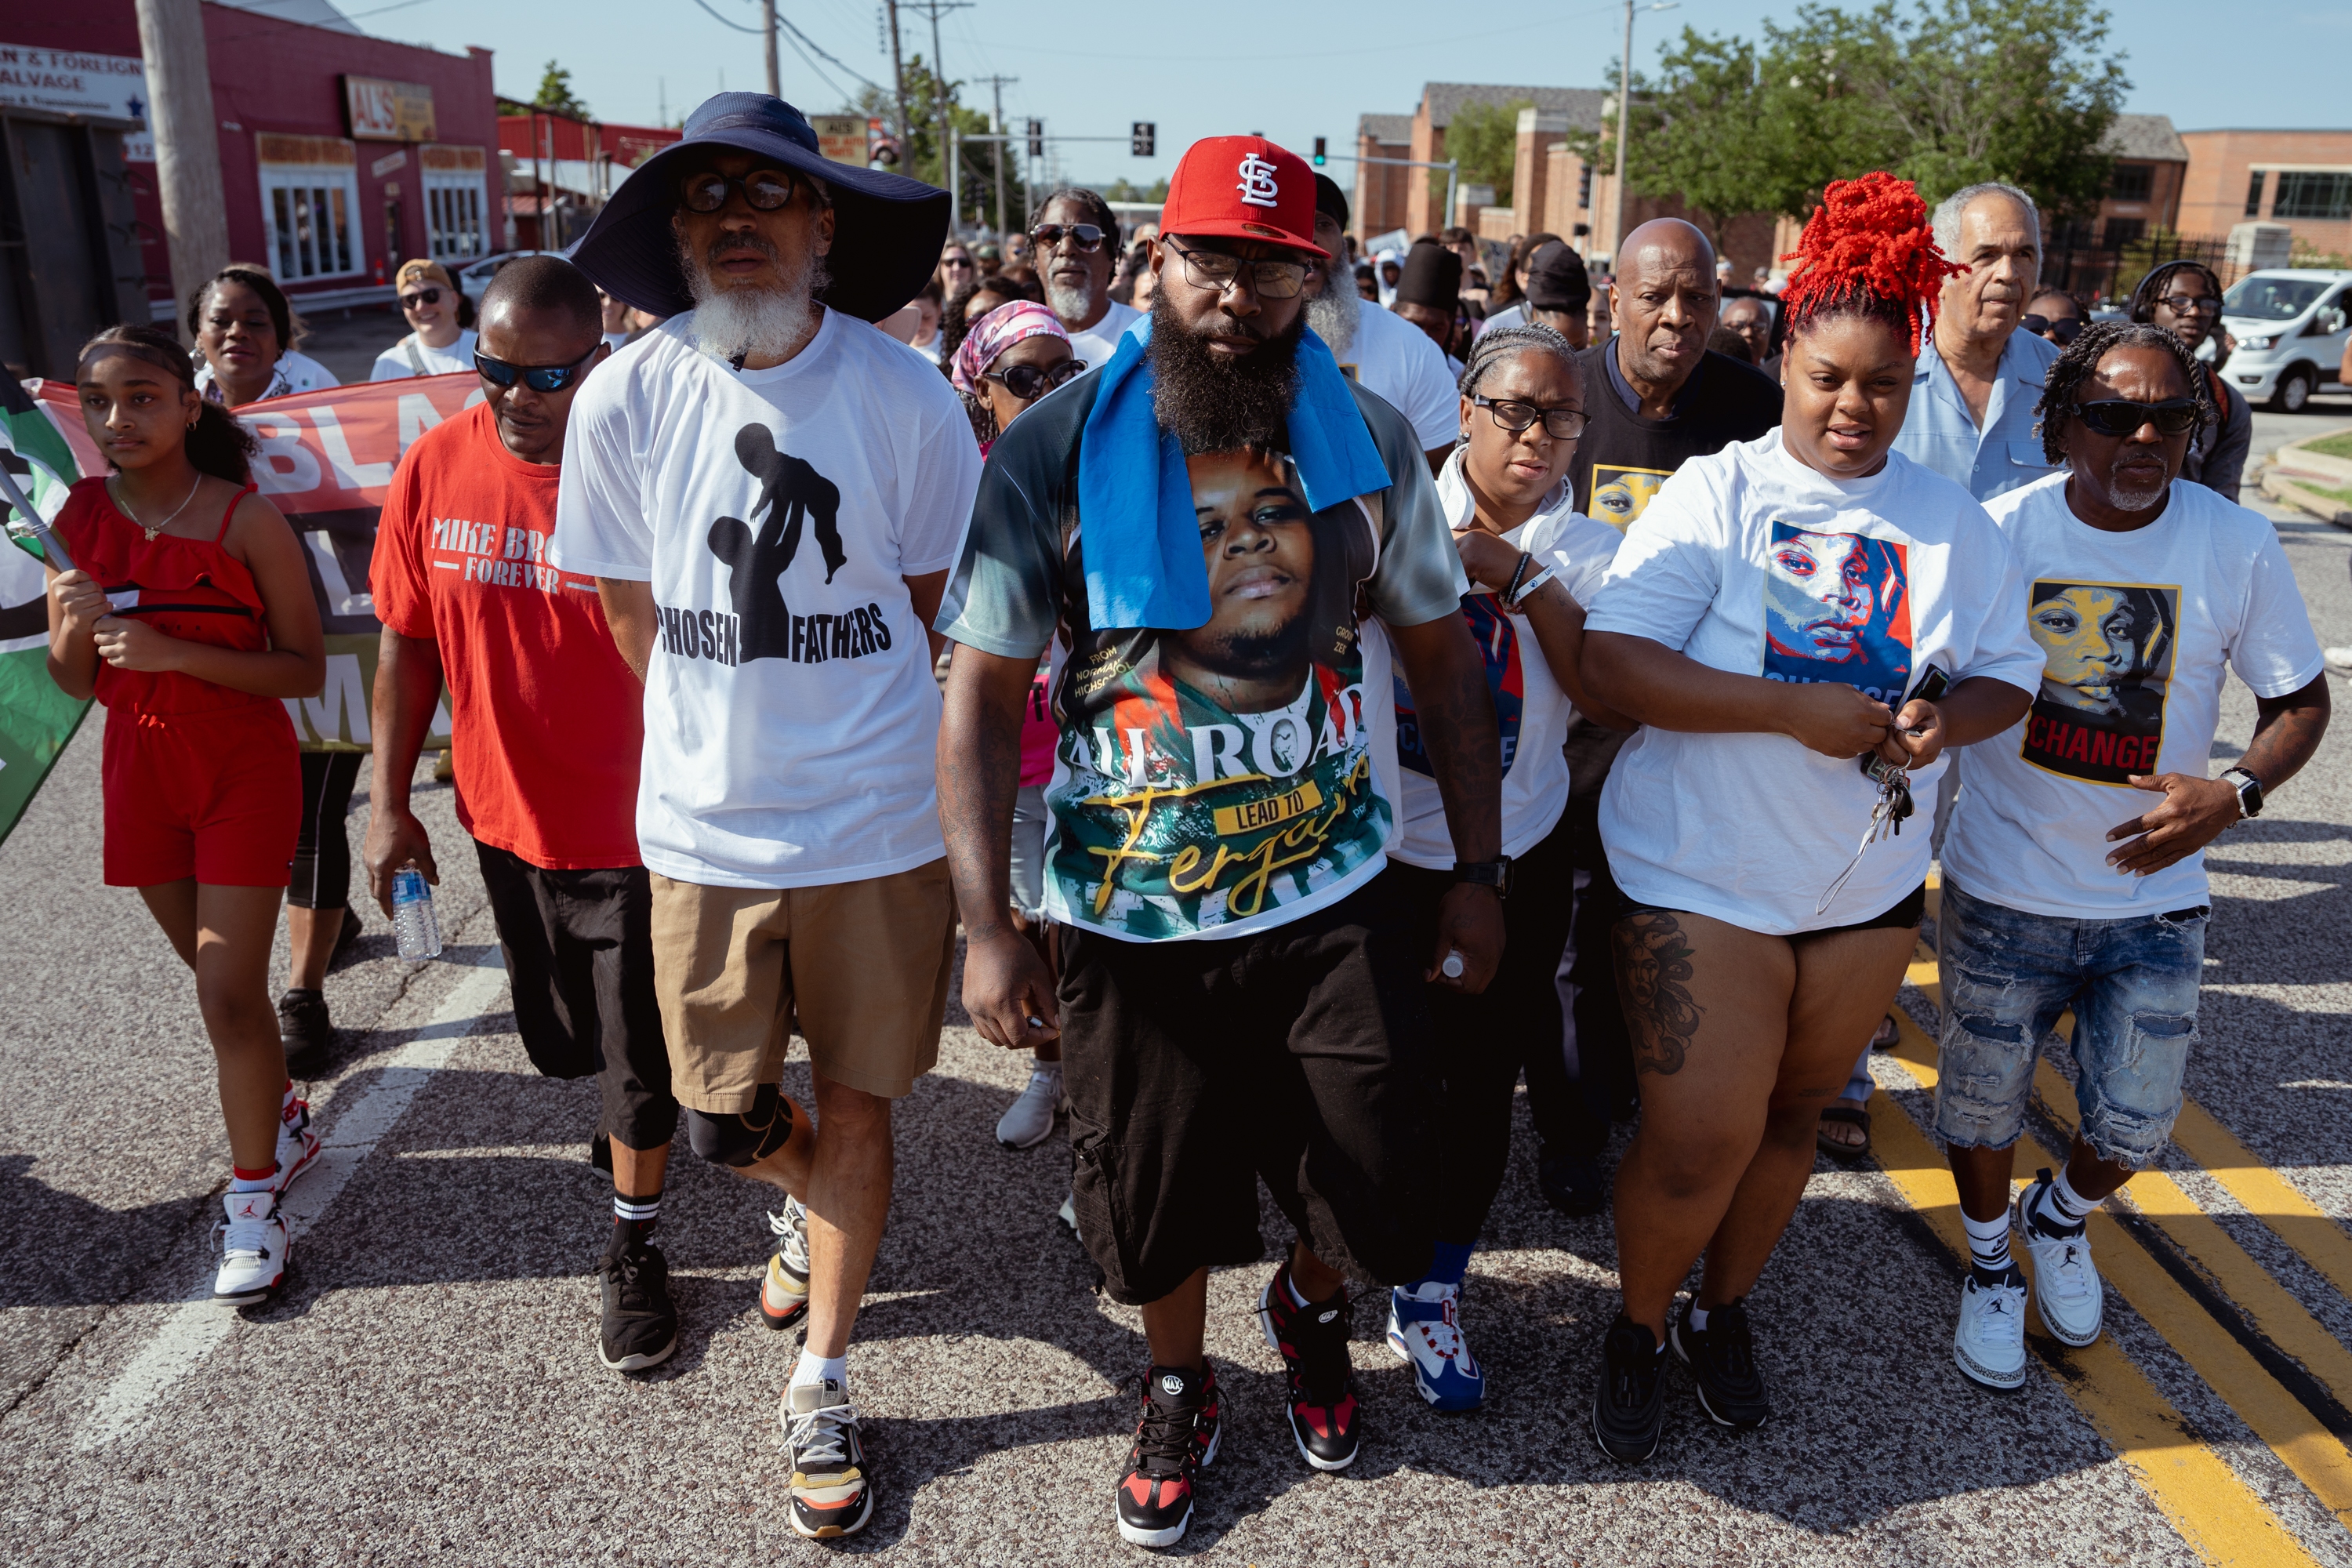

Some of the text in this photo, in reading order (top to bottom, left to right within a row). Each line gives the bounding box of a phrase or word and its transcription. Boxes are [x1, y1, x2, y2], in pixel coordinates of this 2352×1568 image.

[28, 52, 42, 67] &
[50, 53, 143, 75] FOREIGN
[431, 517, 497, 557] MIKE
[464, 556, 560, 594] FOREVER
[792, 602, 892, 664] FATHERS
[1089, 645, 1117, 665] FROM
[2028, 714, 2159, 770] CHANGE
[1236, 789, 1304, 829] LEAD TO
[1163, 1378, 1181, 1390] MAX
